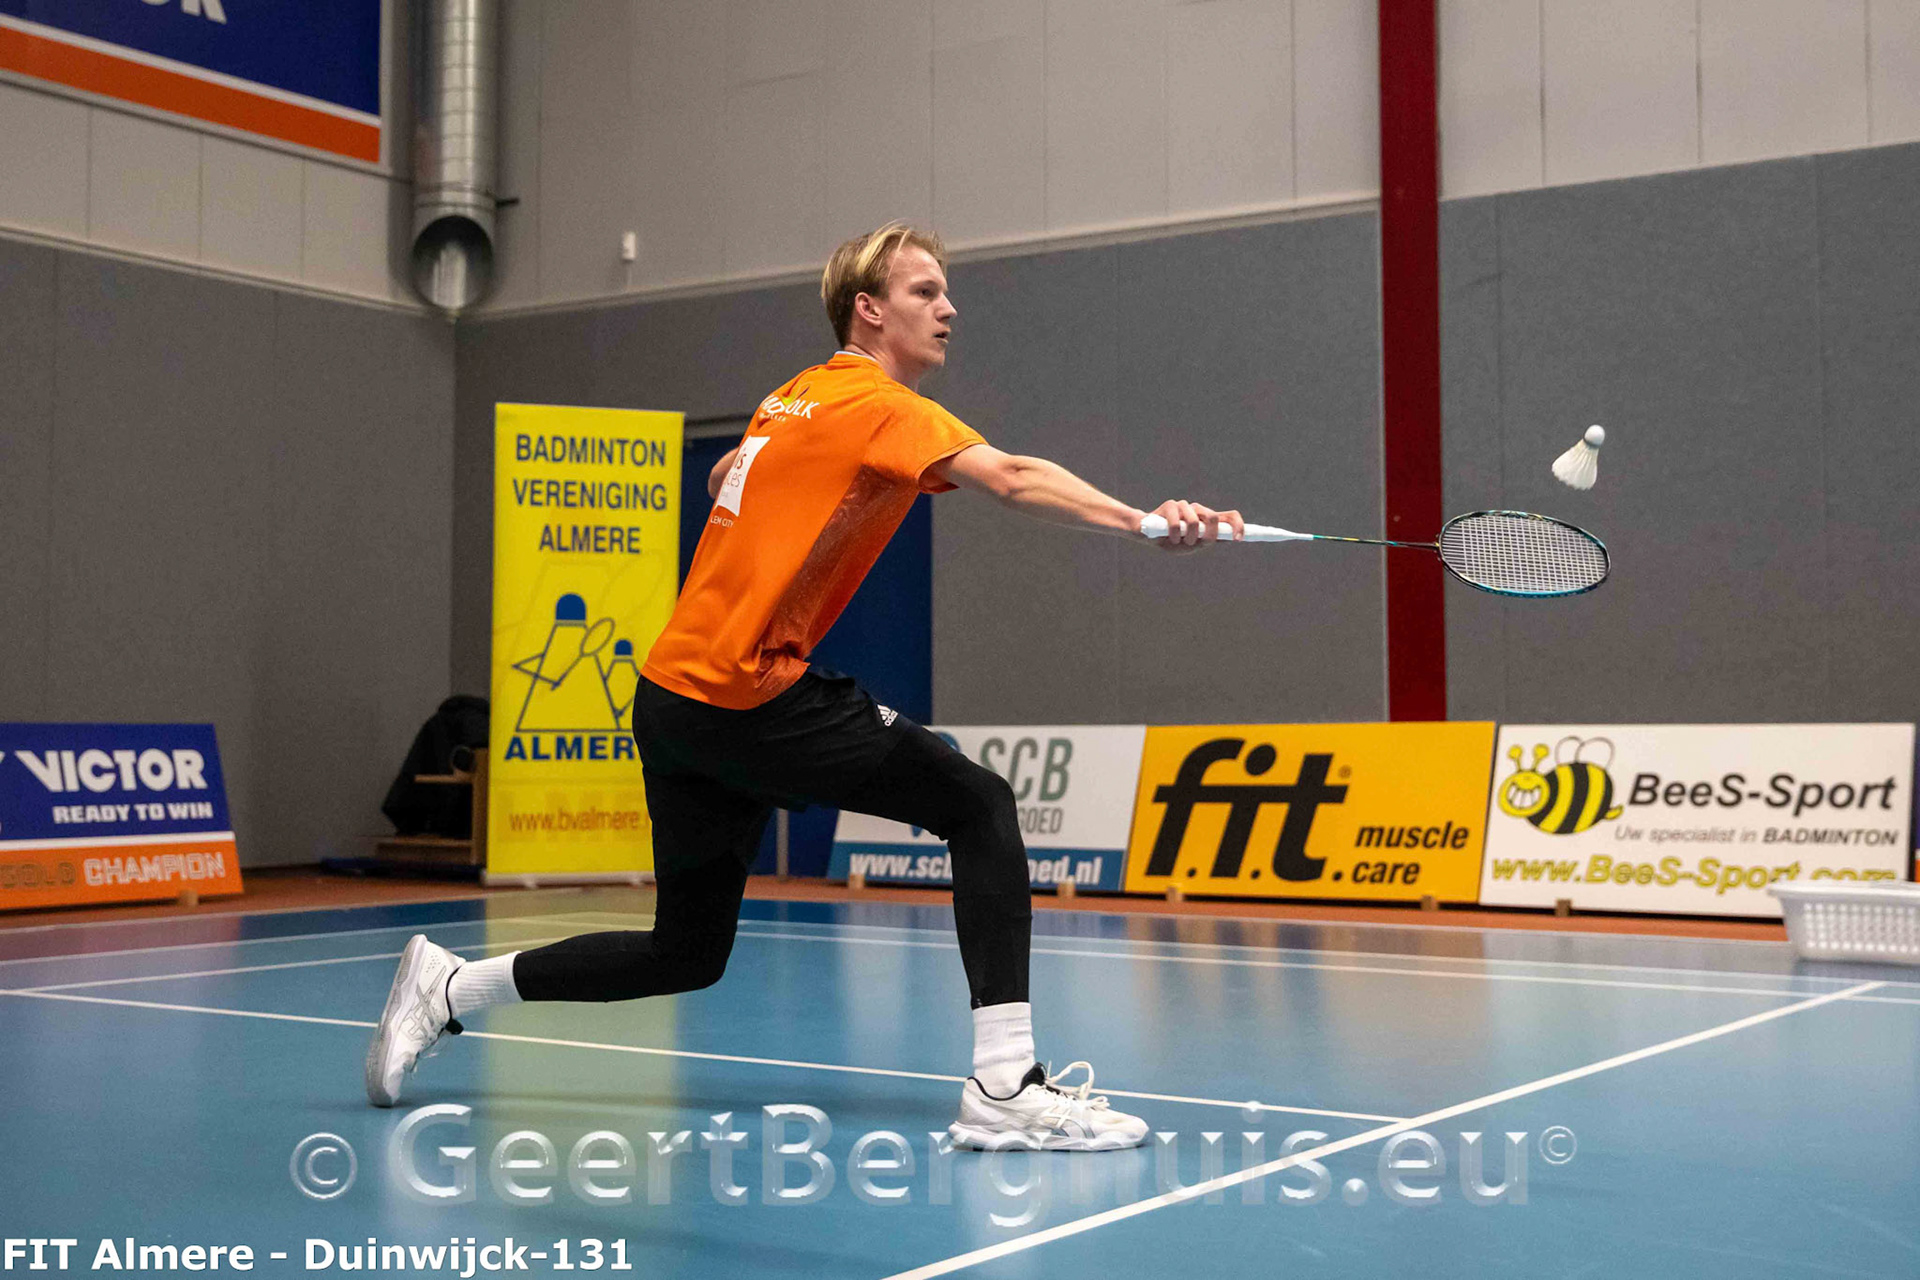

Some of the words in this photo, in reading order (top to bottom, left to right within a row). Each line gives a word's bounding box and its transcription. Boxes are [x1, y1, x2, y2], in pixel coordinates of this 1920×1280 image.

[515, 433, 667, 467] BADMINTON
[512, 478, 668, 511] VERENIGING
[537, 523, 641, 555] ALMERE
[503, 735, 635, 761] ALMER
[14, 748, 208, 793] VICTOR
[1628, 772, 1898, 817] BeeS-Sport
[52, 804, 131, 825] READY
[133, 802, 165, 821] TO
[167, 801, 214, 819] WIN
[509, 804, 652, 833] www.bvalmere.
[1354, 821, 1469, 850] muscle
[1614, 825, 1642, 841] Uw
[1649, 826, 1735, 846] specialist
[1739, 826, 1758, 843] in
[1761, 826, 1900, 847] BADMINTON
[83, 851, 226, 887] CHAMPION
[1351, 860, 1422, 885] care
[1491, 854, 1898, 896] www.BeeS-Sportcom
